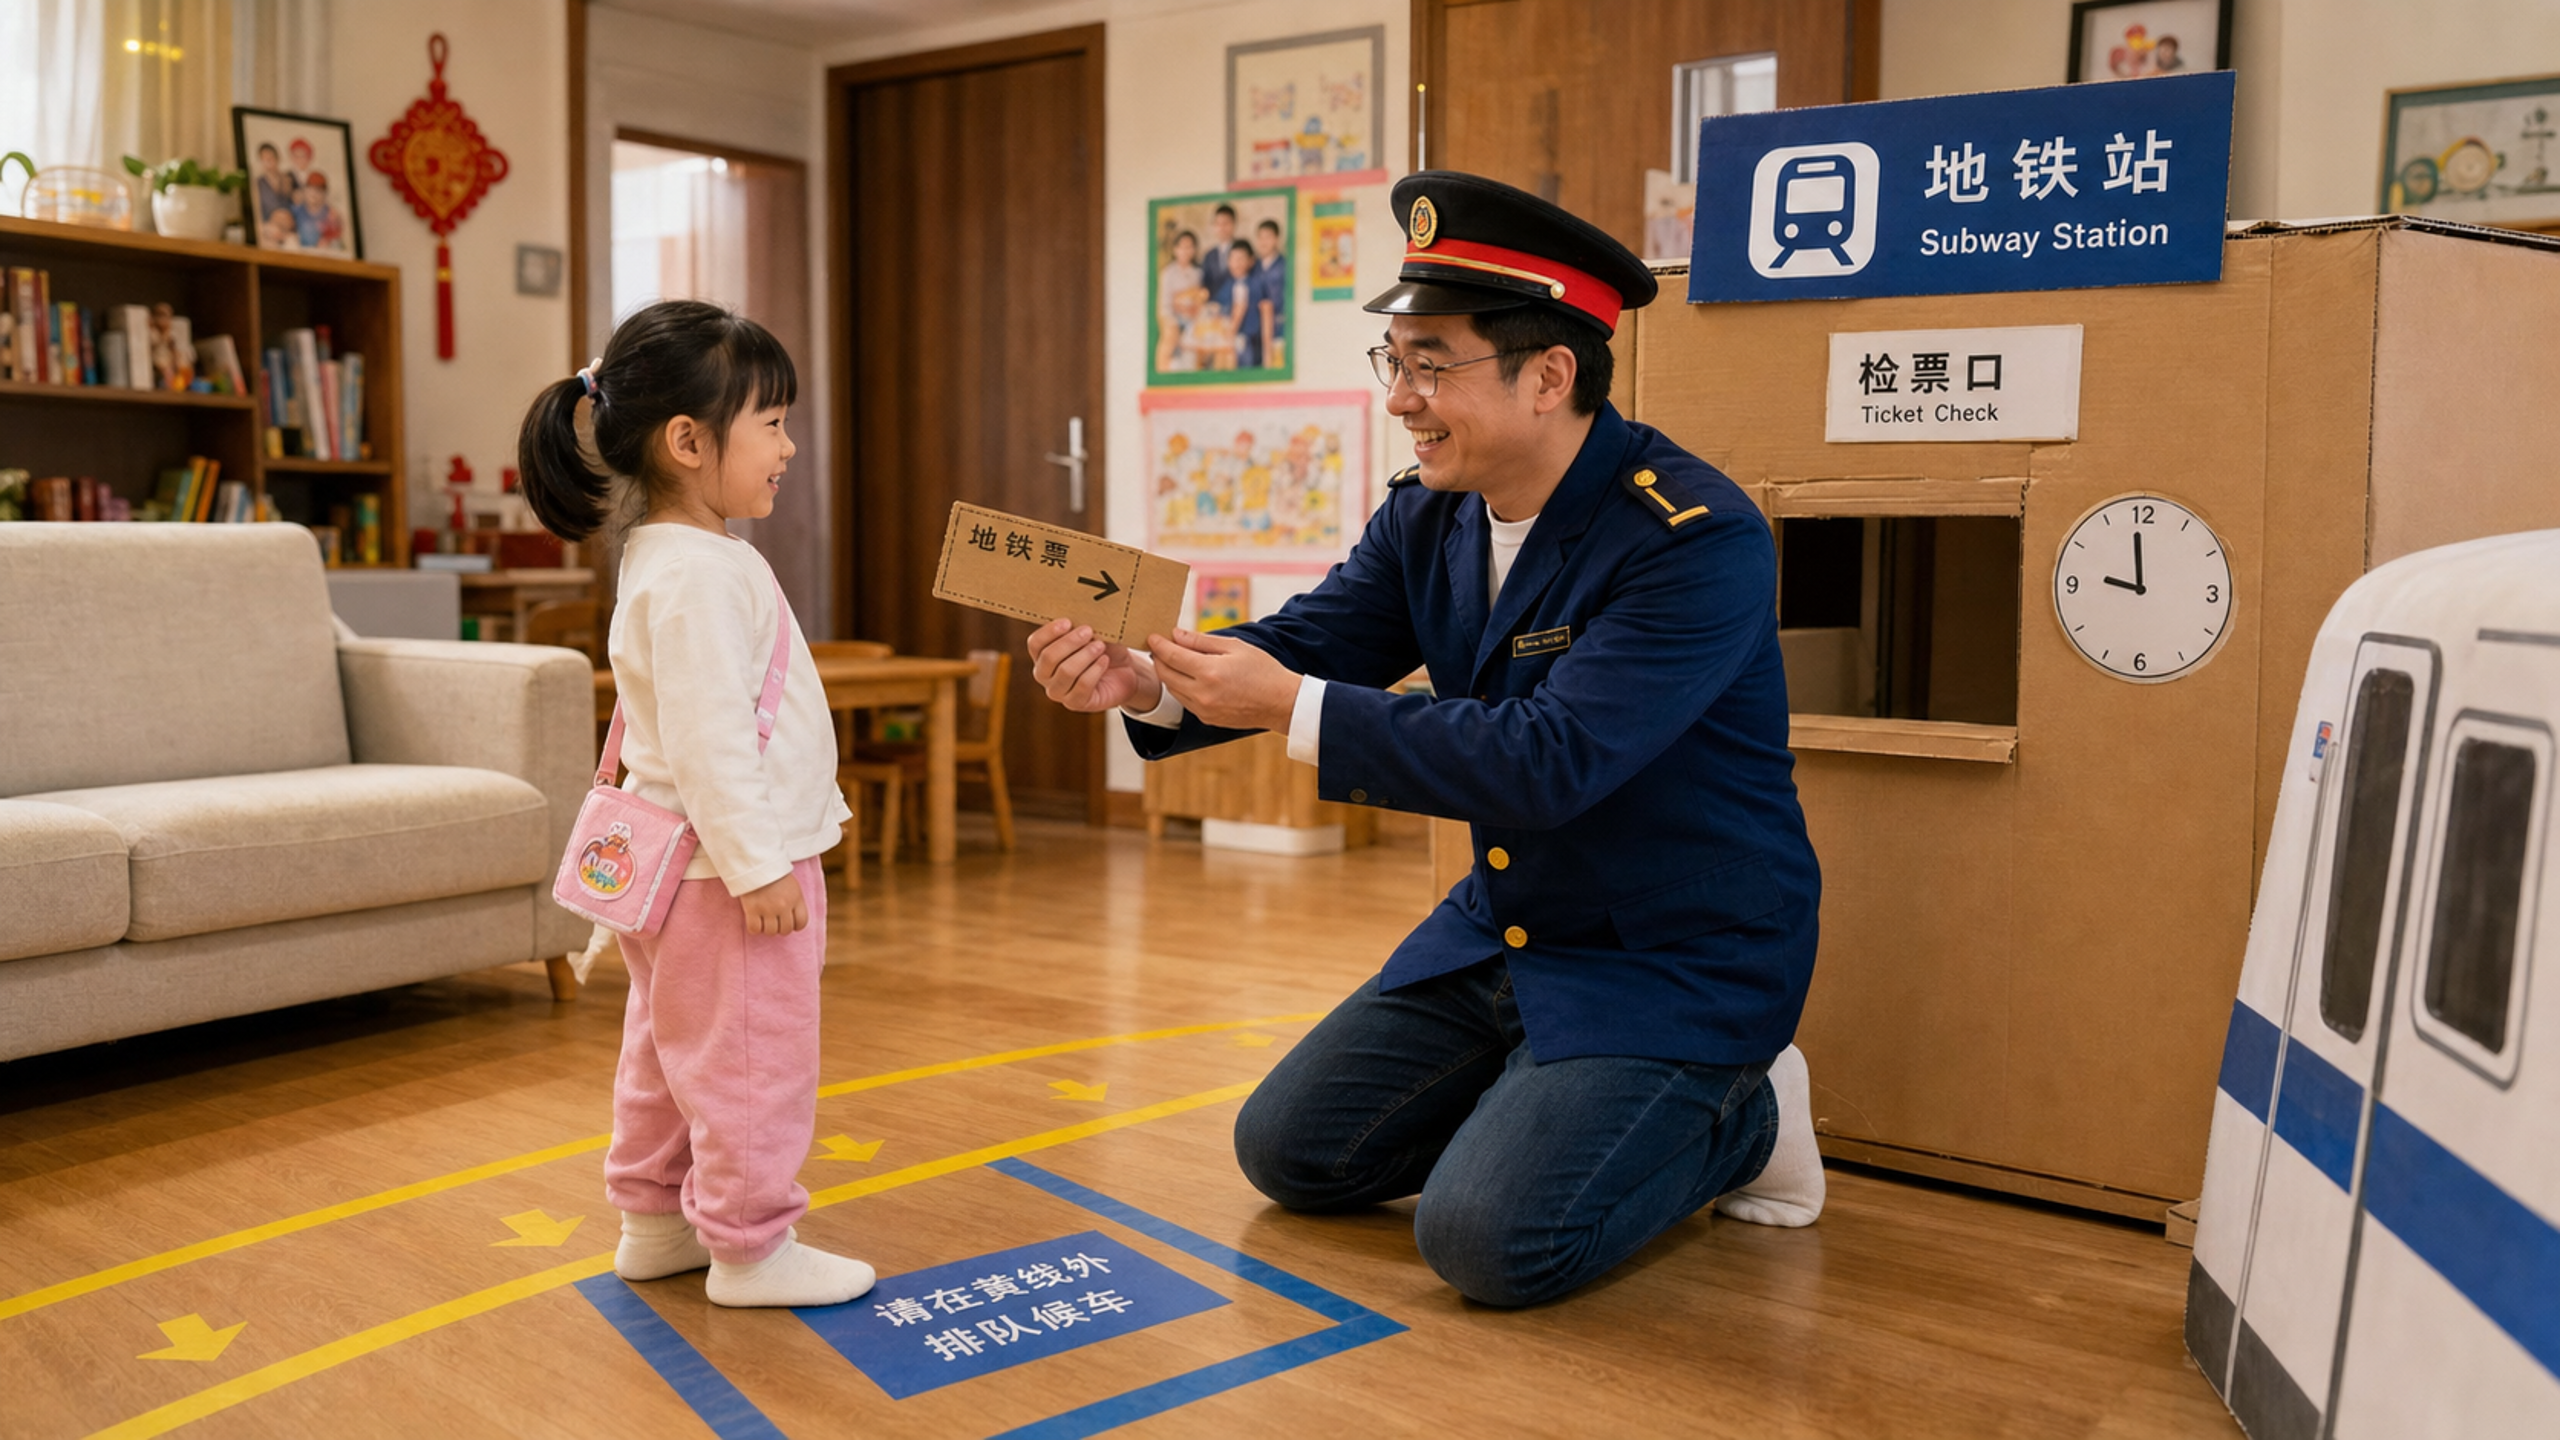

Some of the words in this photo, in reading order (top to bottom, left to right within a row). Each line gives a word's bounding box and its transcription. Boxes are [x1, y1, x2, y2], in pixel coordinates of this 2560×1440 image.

[1924, 129, 2173, 203] 地铁站
[1920, 226, 2041, 259] Subway
[2052, 220, 2169, 251] Station
[1858, 352, 2002, 395] 检票口
[1861, 404, 1924, 424] Ticket
[1934, 403, 1999, 424] Check
[2132, 505, 2155, 524] 12
[967, 523, 1070, 569] 地铁票
[2065, 575, 2079, 594] 9
[2205, 584, 2219, 603] 3
[2133, 652, 2147, 671] 6
[873, 1251, 1112, 1328] 请在黄线外
[923, 1289, 1135, 1362] 排队候车
